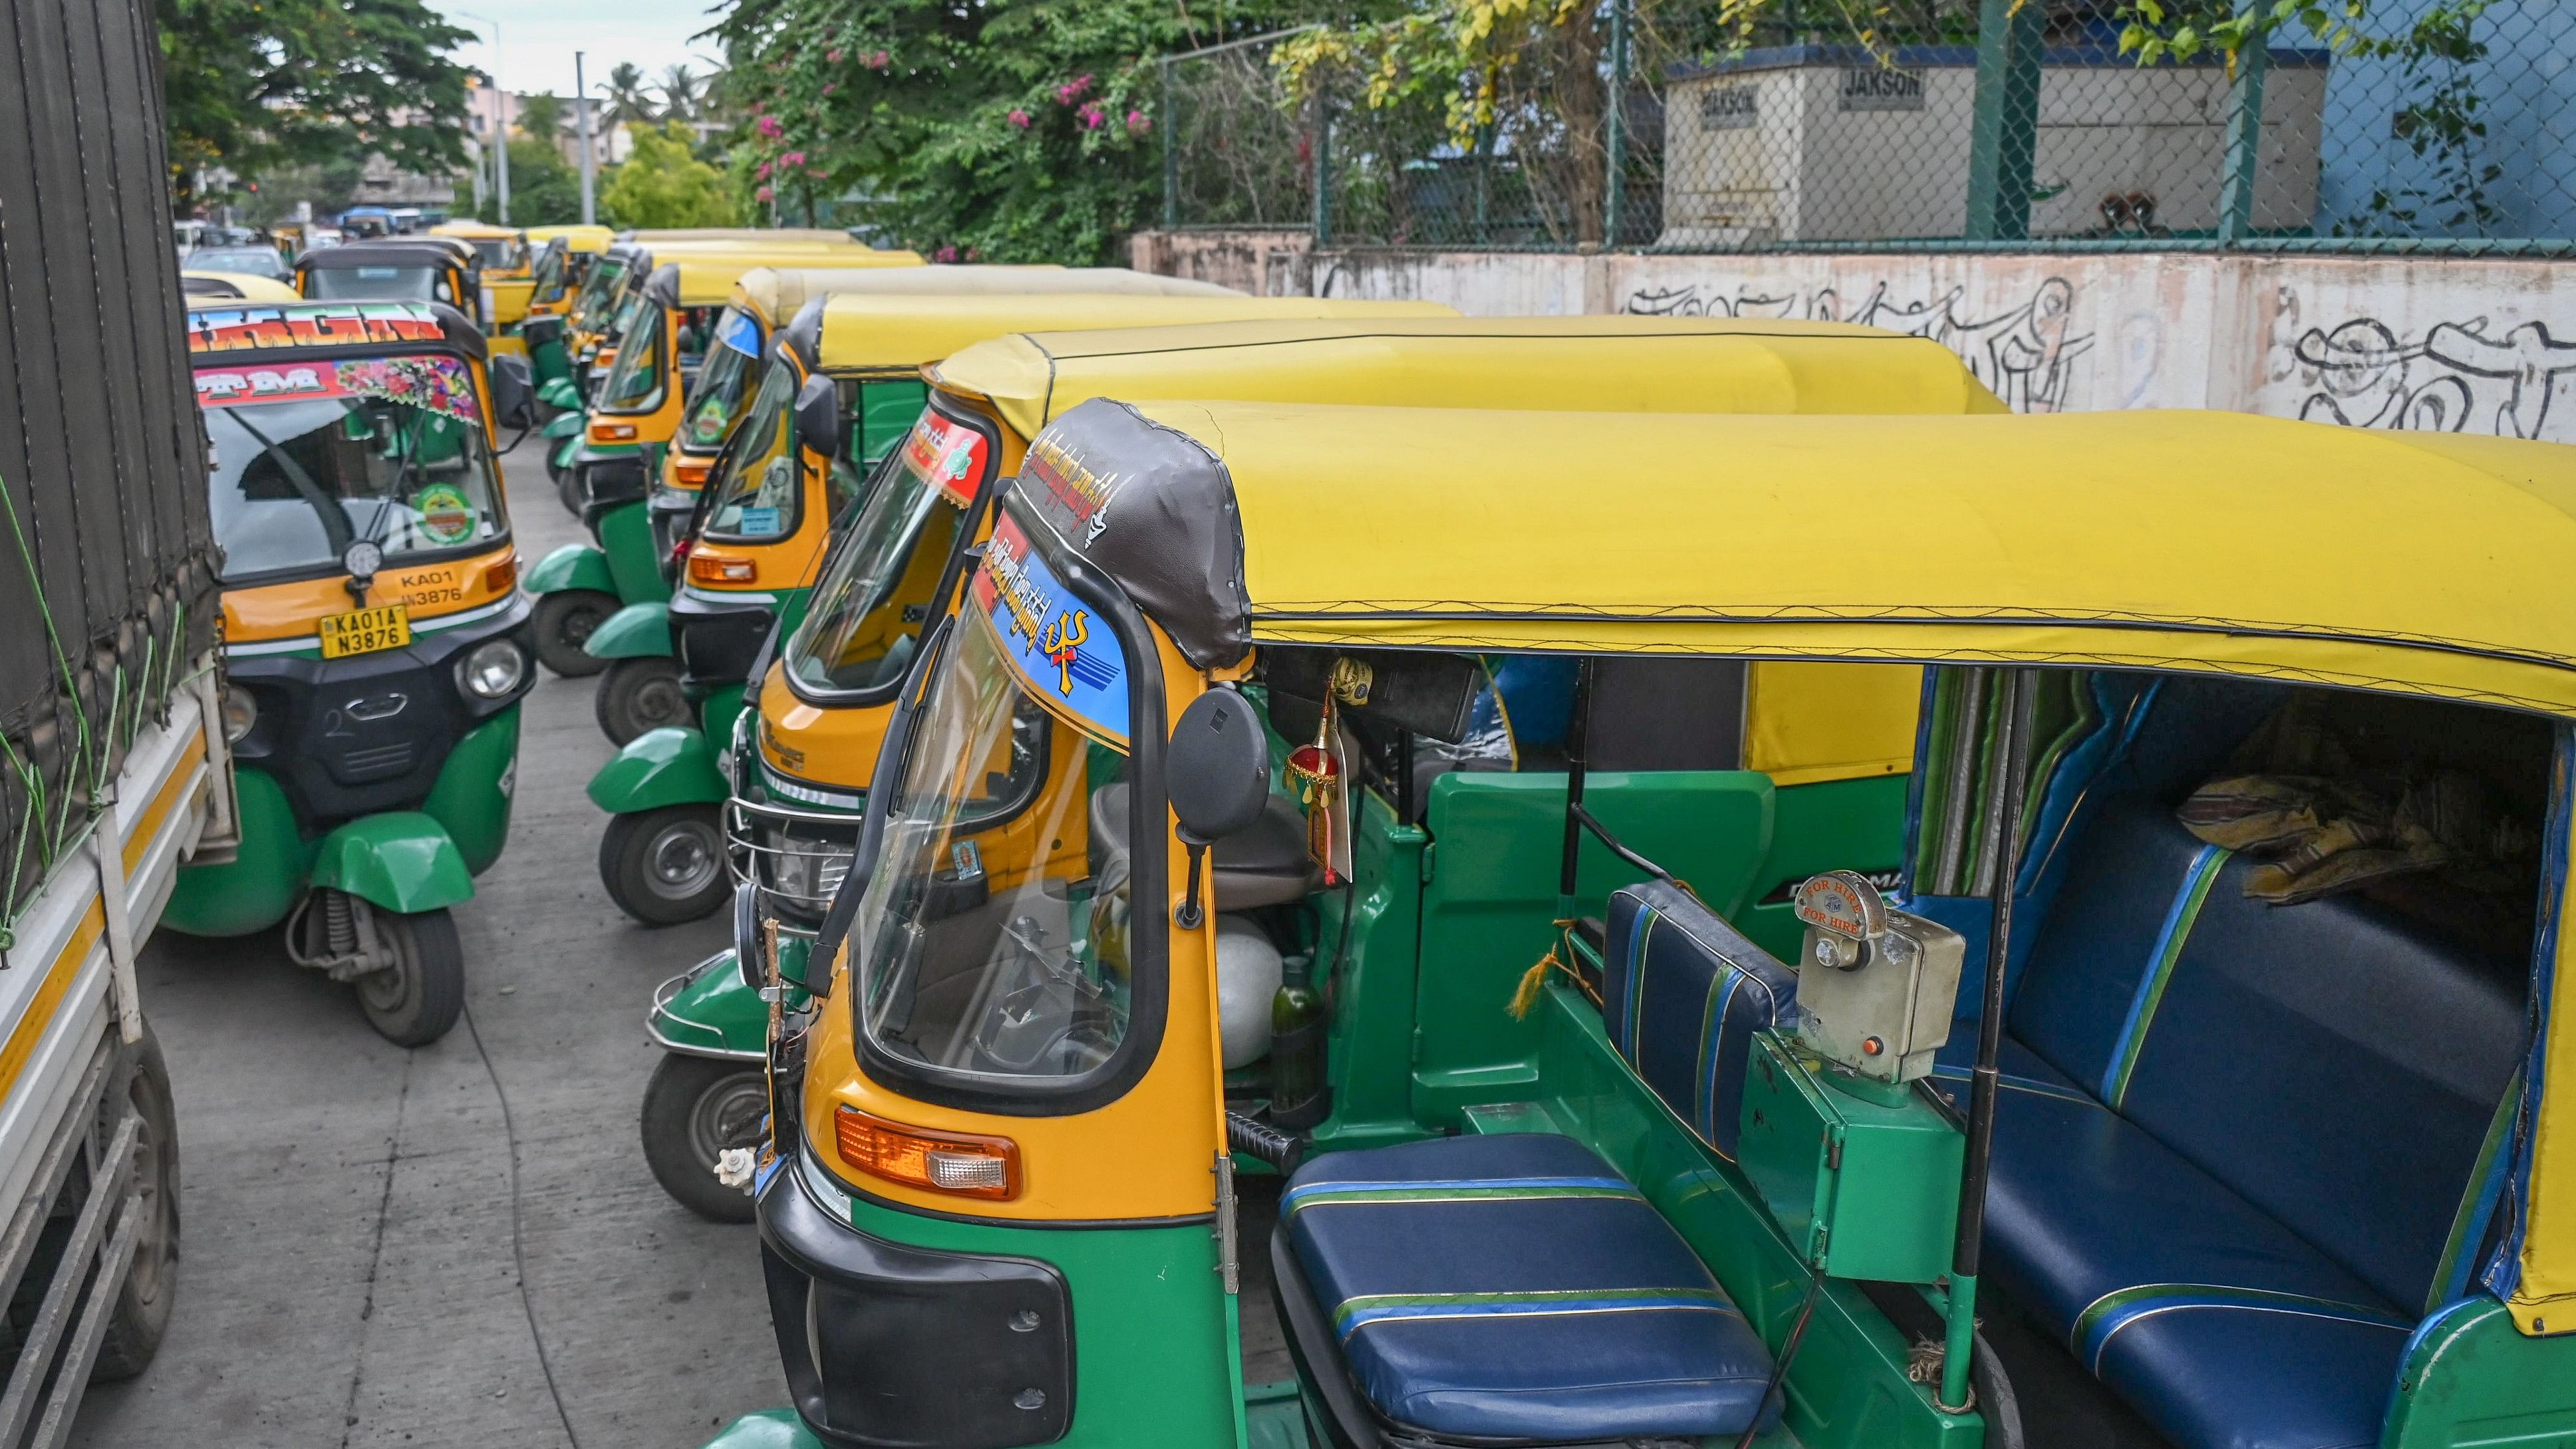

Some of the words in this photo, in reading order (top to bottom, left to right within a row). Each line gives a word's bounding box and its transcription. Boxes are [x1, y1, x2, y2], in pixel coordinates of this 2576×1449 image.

[1845, 68, 1922, 97] JAKSON
[401, 571, 452, 588] KA01
[335, 608, 397, 634] KA01A
[337, 627, 399, 653] N3876
[1806, 879, 1830, 898] FOR
[1834, 881, 1862, 913] HIRE
[1803, 906, 1827, 923] FOR
[1829, 917, 1860, 935] HIRE
